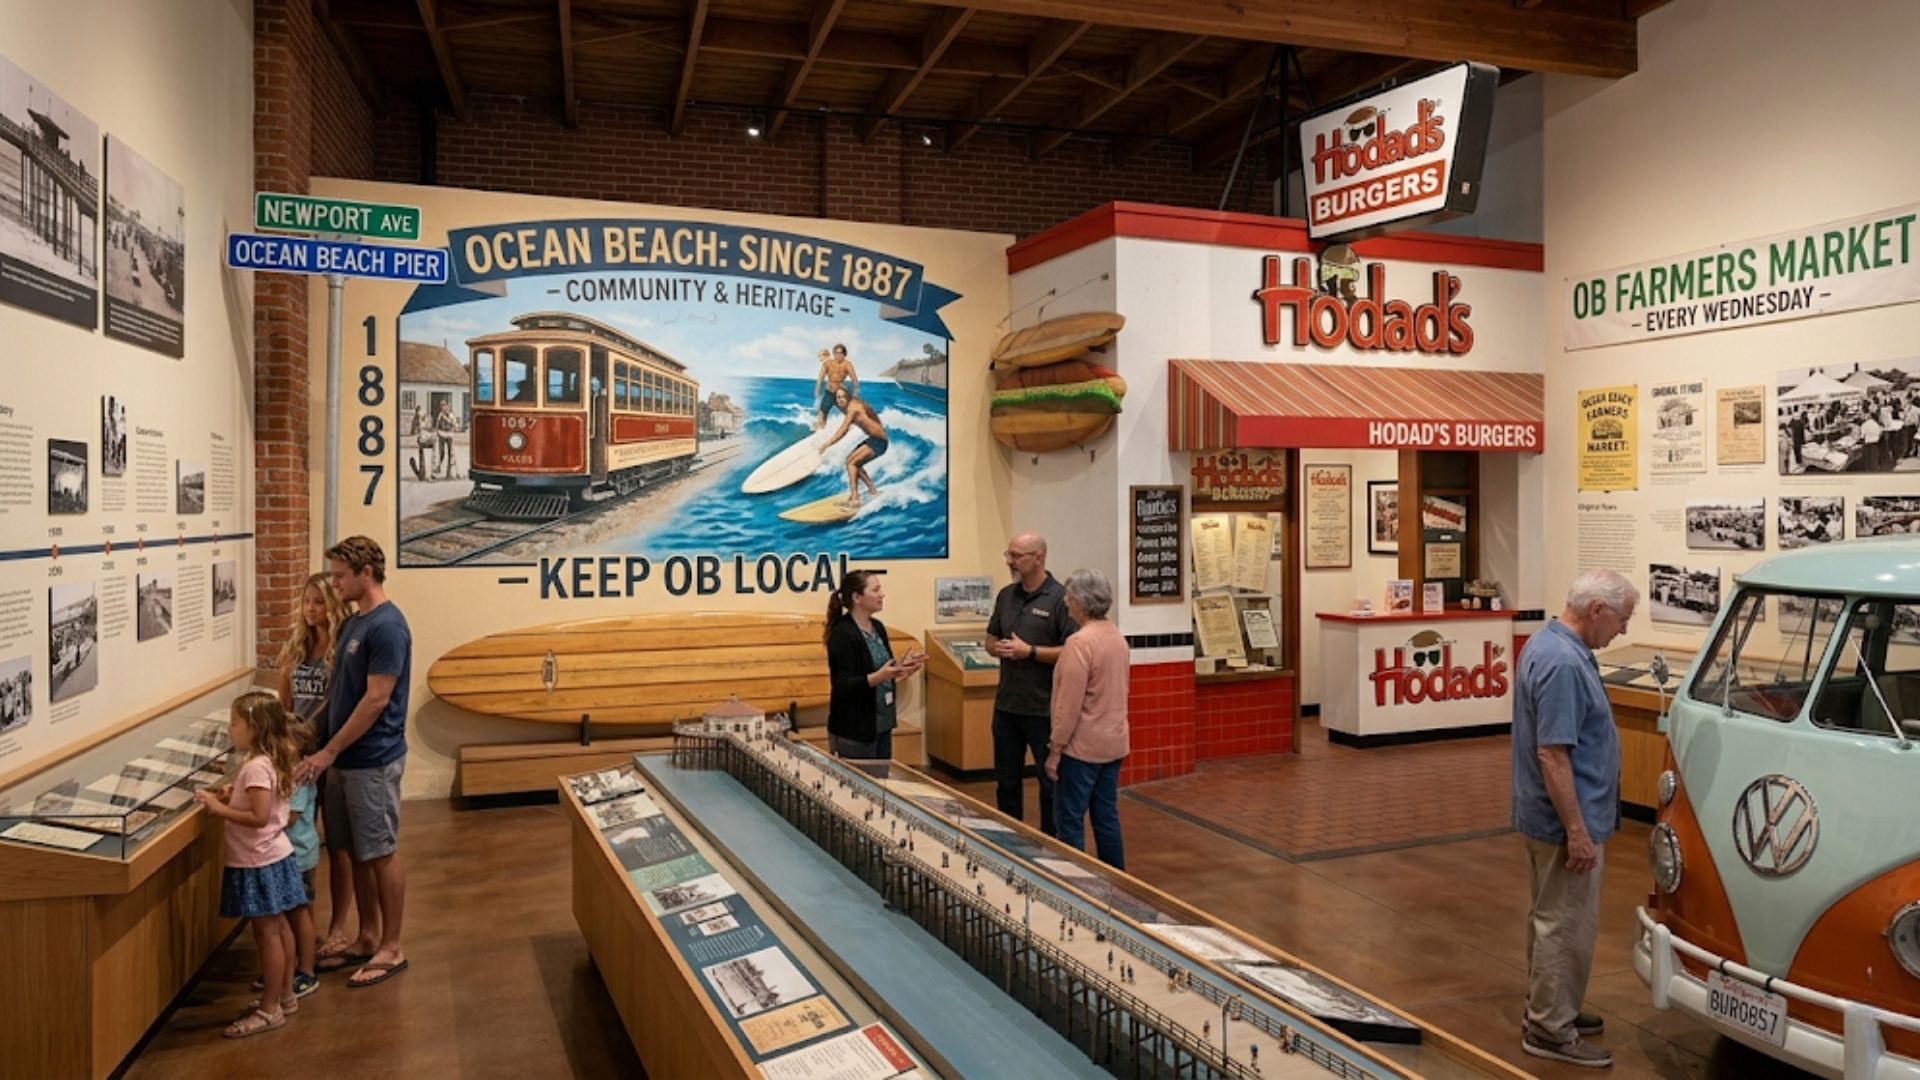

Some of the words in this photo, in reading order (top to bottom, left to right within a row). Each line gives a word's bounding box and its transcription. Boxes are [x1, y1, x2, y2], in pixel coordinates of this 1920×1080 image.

[1311, 98, 1445, 185] Hodad's
[263, 200, 372, 231] NEWPORT
[380, 213, 413, 233] AVE
[1315, 167, 1439, 221] BURGERS
[235, 239, 308, 267] OCEAN
[316, 246, 385, 274] BEACH
[393, 252, 440, 278] PIER
[464, 226, 593, 275] OCEAN
[602, 226, 728, 267] BEACH:
[738, 234, 833, 283] SINCE
[841, 252, 913, 301] 1887
[1572, 278, 1607, 320] OB
[1615, 248, 1757, 313] FARMERS
[1769, 214, 1917, 287] MARKET
[565, 277, 708, 303] COMMUNITY
[713, 280, 730, 305] &
[736, 283, 836, 318] HERITAGE
[1252, 254, 1475, 355] Hodad's
[1646, 305, 1699, 332] EVERY
[1702, 286, 1815, 323] WEDNESDAY
[1368, 421, 1450, 446] HODAD'S
[1456, 423, 1537, 448] BURGERS
[539, 557, 651, 599] KEEP
[663, 555, 722, 597] OB
[1368, 640, 1509, 707] Hodad's
